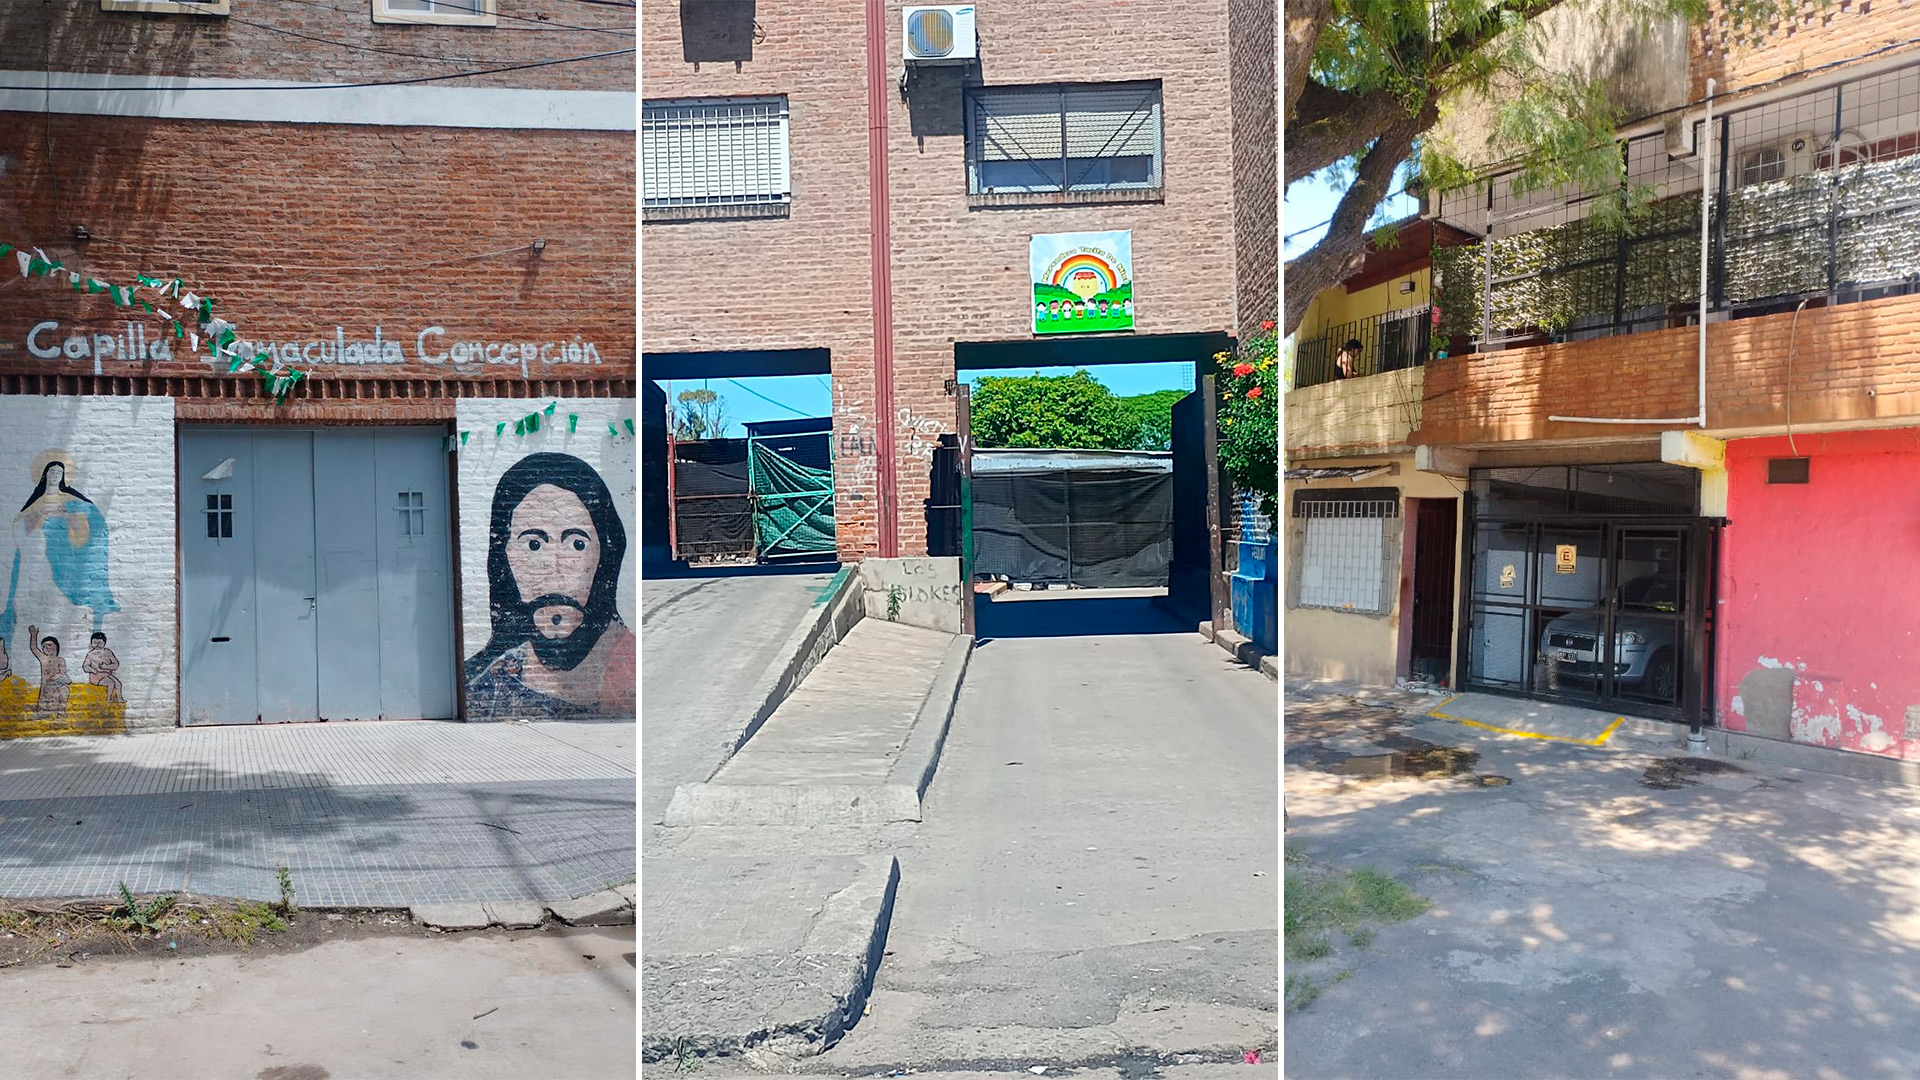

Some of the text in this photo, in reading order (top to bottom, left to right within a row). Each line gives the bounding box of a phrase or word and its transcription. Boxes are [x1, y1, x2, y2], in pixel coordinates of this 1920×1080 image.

[27, 321, 173, 375] Capilla
[416, 326, 602, 378] Concepción
[1563, 551, 1570, 561] E
